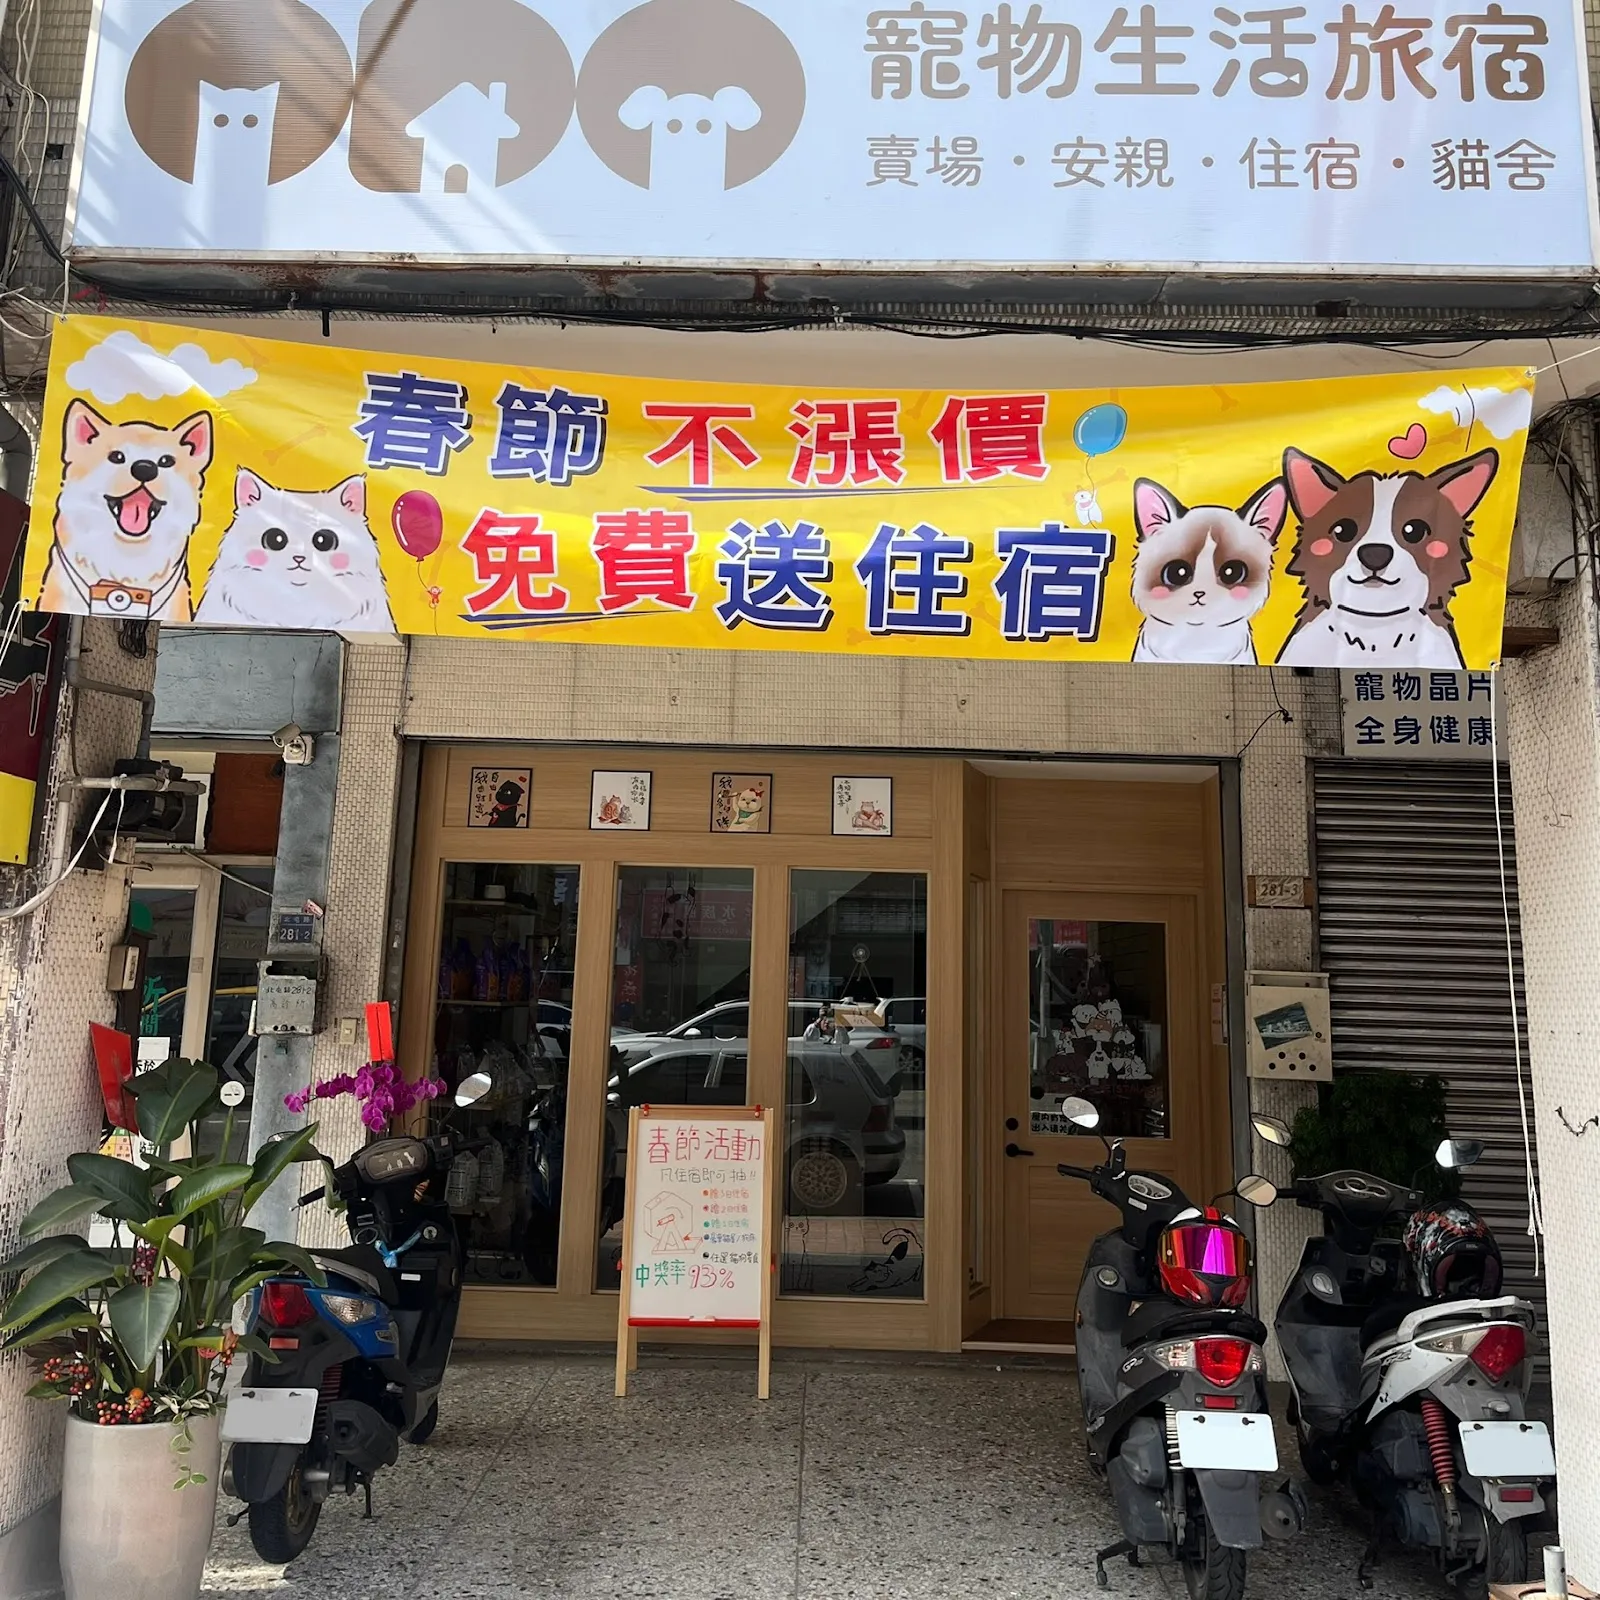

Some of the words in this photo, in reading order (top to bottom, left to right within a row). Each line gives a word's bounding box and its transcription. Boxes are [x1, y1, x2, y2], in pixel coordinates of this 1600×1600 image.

[864, 3, 1549, 101] 寵物生活旅宿
[353, 371, 1048, 486] 春節不漲價
[460, 509, 1114, 642] 免費送住宿
[1354, 672, 1492, 702] 寵物晶片
[1354, 715, 1498, 746] 全身健康
[1260, 882, 1299, 897] 281-3
[280, 928, 311, 941] 281-2
[648, 1125, 761, 1163] 春節活動
